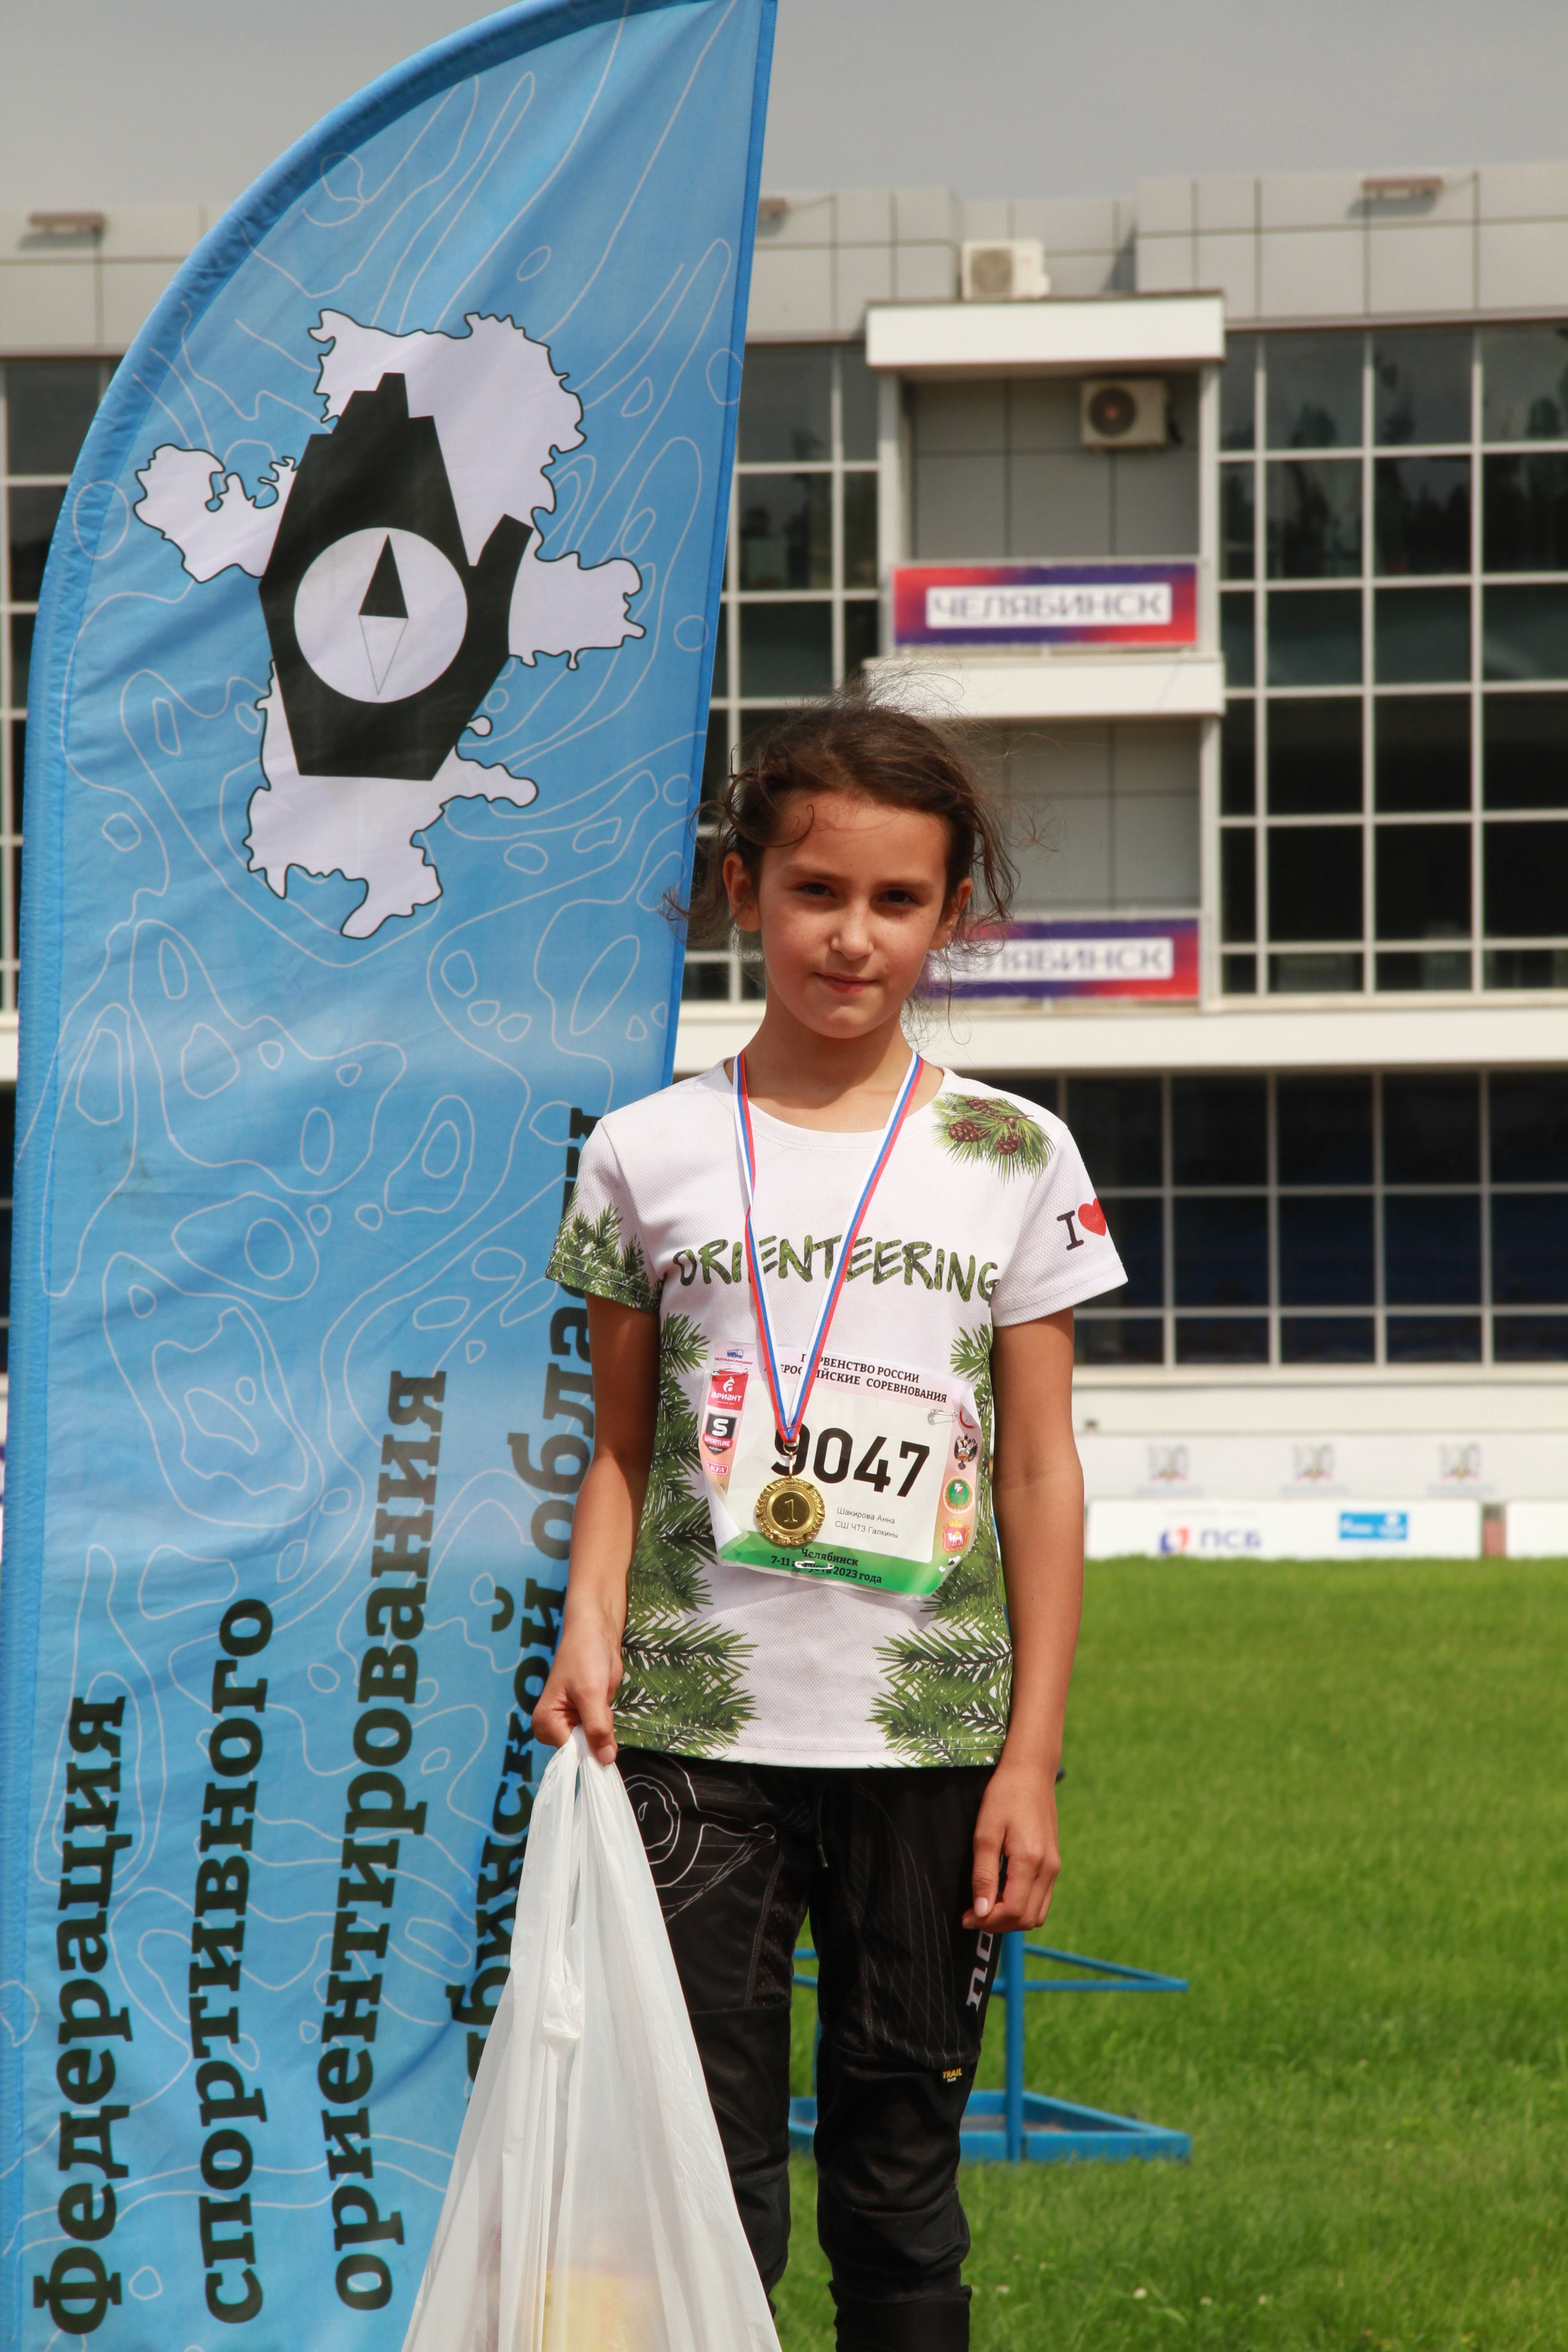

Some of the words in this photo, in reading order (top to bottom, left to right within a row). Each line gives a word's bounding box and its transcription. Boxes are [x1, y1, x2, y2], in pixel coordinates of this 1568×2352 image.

[934, 588, 1164, 622] ЧЕЛЯБИНСК
[956, 944, 1165, 972] ЛЯБИНСК
[673, 1234, 1000, 1307] ORIENTEERING
[877, 1366, 920, 1383] РОССИИ
[866, 1378, 948, 1403] СОРЕВНОВАНИЯ
[704, 1436, 731, 1447] SPORTLINE
[771, 1423, 930, 1498] 9047
[837, 1507, 875, 1520] Шакирова
[876, 1515, 895, 1524] Анна
[835, 1520, 849, 1529] СШ
[868, 1526, 899, 1539] Галкины
[1199, 1528, 1262, 1550] ПСБ
[771, 1555, 790, 1567] 7-11
[833, 1566, 858, 1579] 2023
[859, 1572, 882, 1584] года
[801, 1548, 859, 1567] Челябинск
[317, 1370, 447, 2311] ориентирования
[188, 1597, 274, 2324] спортивного
[32, 1696, 133, 2334] Федерация
[943, 2068, 962, 2079] TRAIL
